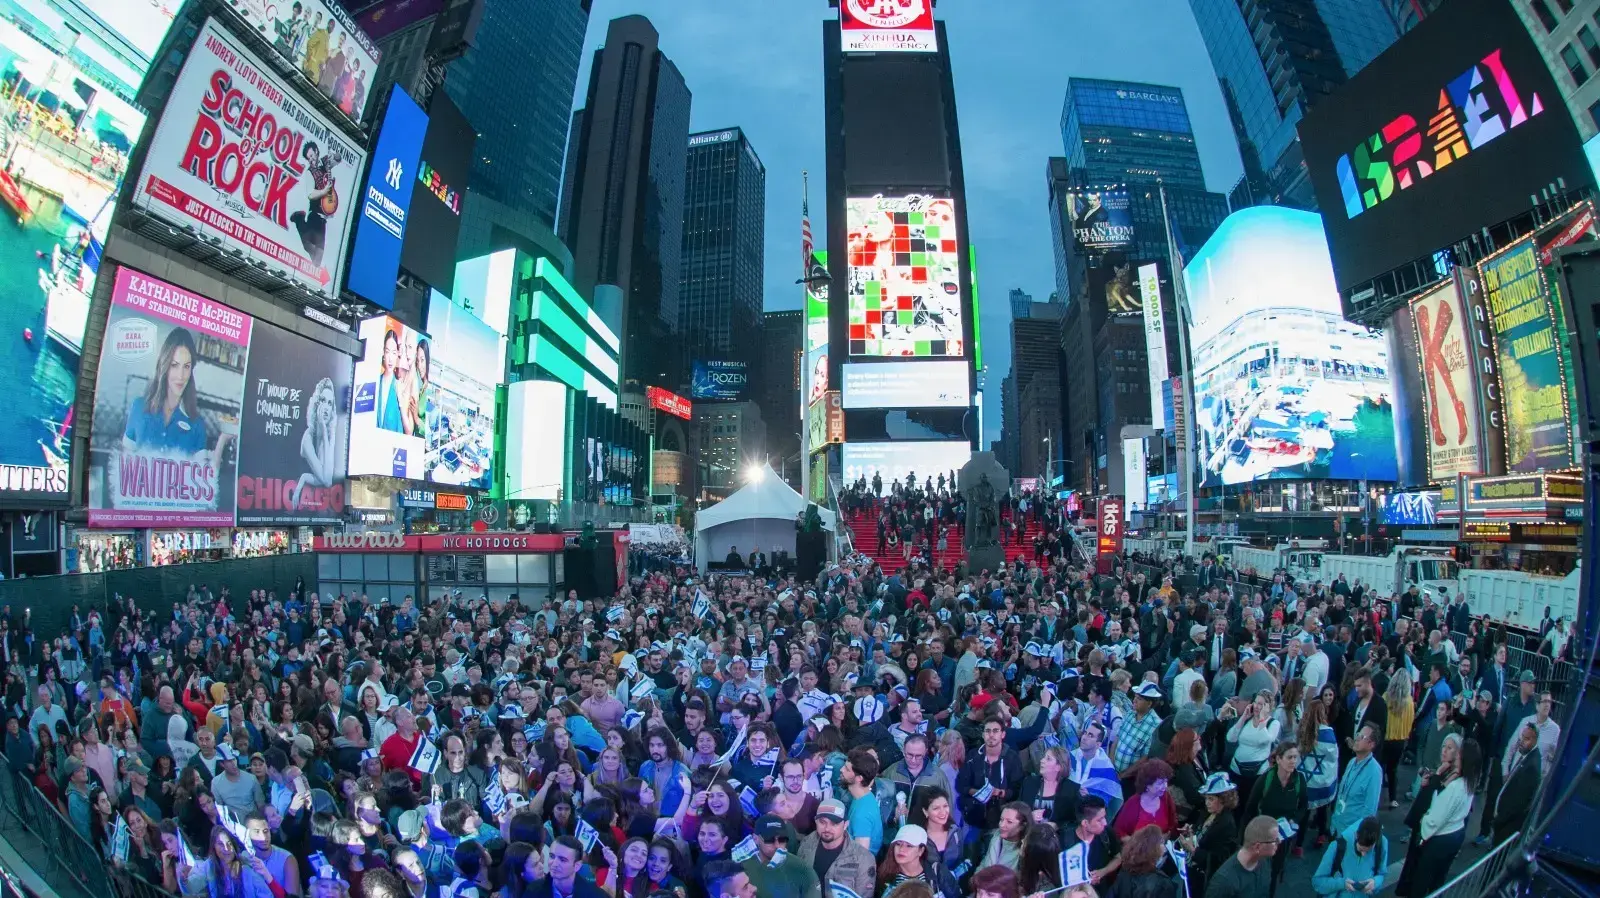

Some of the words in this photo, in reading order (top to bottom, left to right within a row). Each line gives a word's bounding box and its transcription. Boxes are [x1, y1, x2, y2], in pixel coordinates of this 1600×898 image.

[355, 31, 370, 50] AUG
[862, 34, 916, 42] XINHUA
[234, 59, 258, 85] LLOYD
[256, 75, 284, 108] WEBBER
[281, 98, 297, 118] HAS
[295, 109, 330, 144] BROADWAY
[1129, 91, 1178, 104] BARCLAYS
[200, 69, 305, 177] SCHOOL
[1336, 48, 1544, 220] ISRAEL
[239, 136, 265, 167] of
[689, 135, 719, 146] Allianz
[179, 109, 300, 231] ROCK
[418, 161, 460, 216] ISRAEL
[225, 200, 246, 213] MUSICAL
[185, 199, 205, 217] JUST
[204, 207, 210, 221] 4
[209, 210, 235, 234] BLOCKS
[234, 224, 243, 237] TO
[243, 229, 256, 244] THE
[255, 234, 278, 257] WINTER
[278, 246, 300, 268] GARDEN
[1073, 226, 1134, 238] PHANTOM
[128, 275, 199, 312] KATHARINE
[200, 302, 243, 329] McPHEE
[126, 293, 147, 307] NOW
[148, 300, 187, 321] STARRING
[188, 314, 200, 326] ON
[201, 318, 241, 339] BROADWAY
[1153, 320, 1162, 332] SF
[1469, 278, 1499, 429] PALACE
[707, 370, 747, 384] FROZEN
[257, 378, 269, 396] IT
[267, 383, 289, 400] WOULD
[289, 389, 302, 401] BE
[256, 399, 291, 419] CRIMINAL
[291, 405, 300, 420] TO
[265, 419, 282, 436] MISS
[283, 422, 292, 437] IT
[1173, 394, 1186, 452] EXPERIENCE
[119, 454, 214, 502] WAITRESS
[237, 474, 345, 513] CHICAGO
[423, 490, 435, 502] FIN
[1103, 503, 1119, 536] tkts
[164, 532, 211, 550] GRAND
[235, 530, 269, 549] SLAM
[323, 529, 406, 549] nuchas
[443, 537, 461, 548] NYC
[466, 537, 528, 548] HOTDOGS
